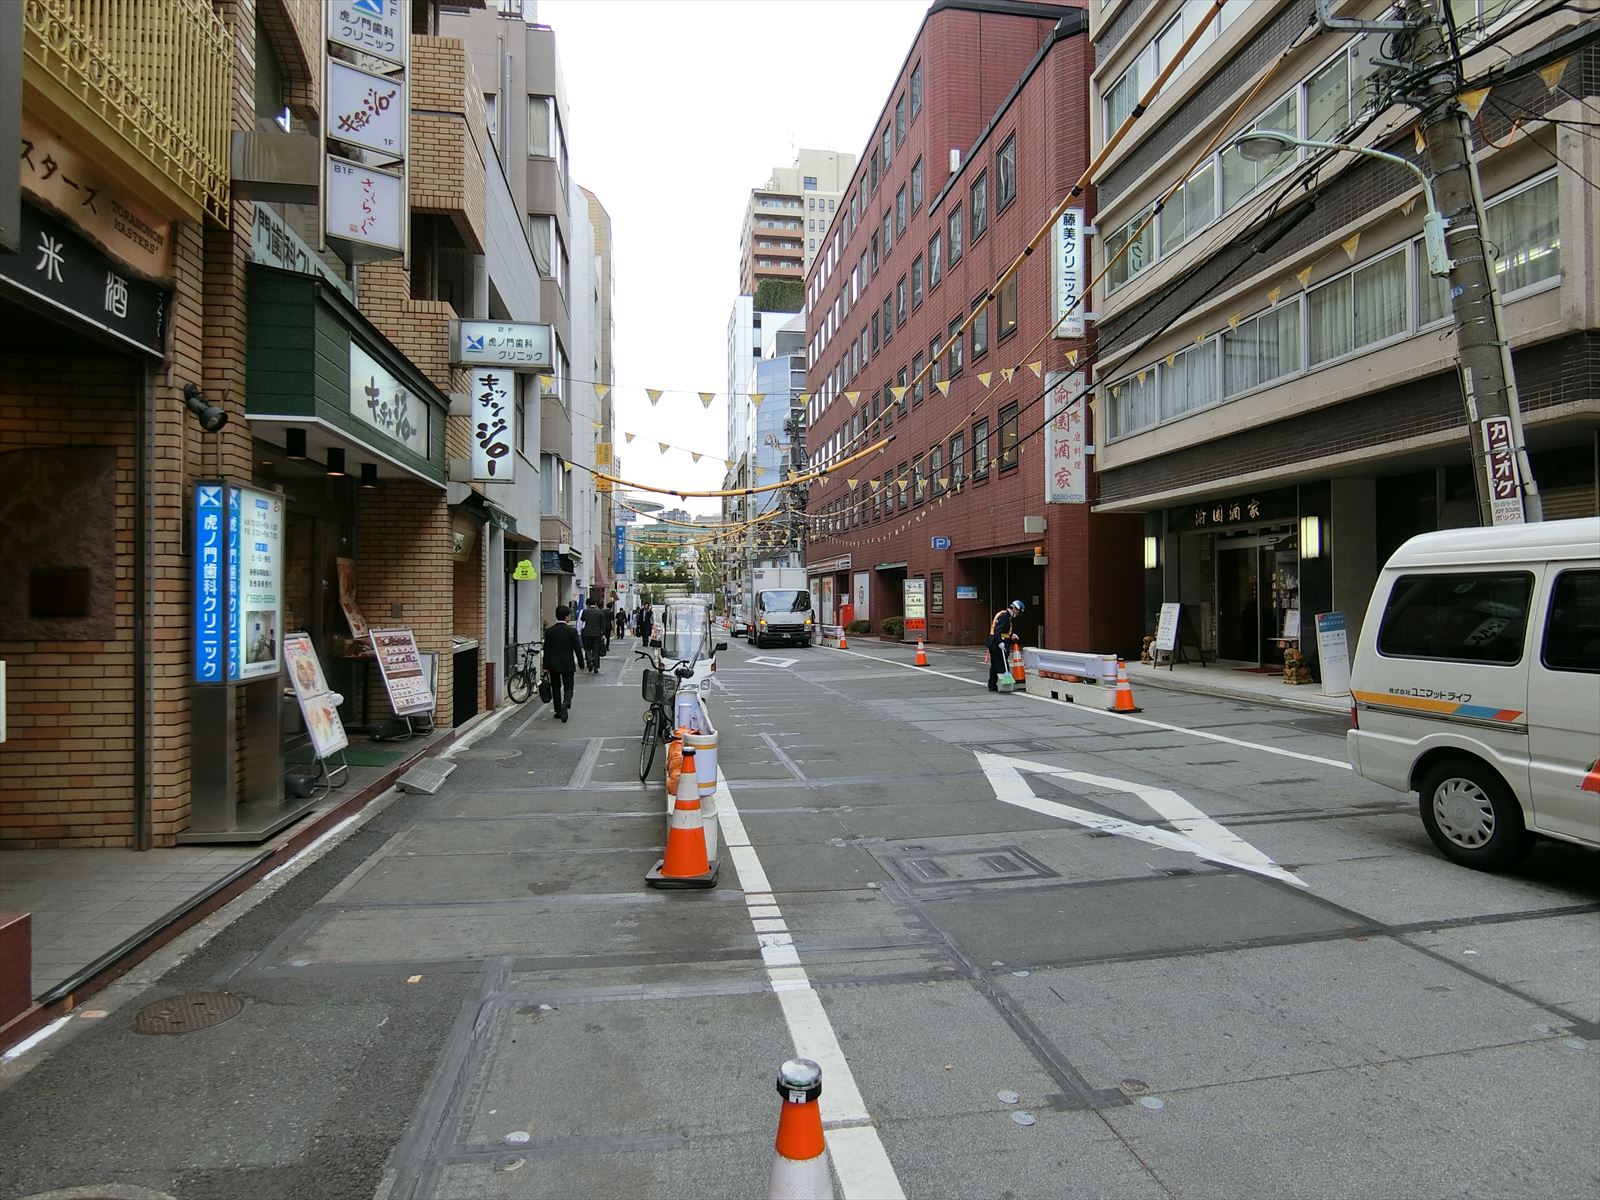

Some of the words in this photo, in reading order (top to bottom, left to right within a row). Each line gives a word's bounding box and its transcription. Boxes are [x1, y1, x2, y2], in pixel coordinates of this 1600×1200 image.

[340, 10, 393, 39] 虎ノ門歯科
[342, 26, 394, 52] クリニック
[384, 138, 394, 146] 1F
[334, 164, 353, 176] B1F
[361, 178, 376, 235] さくらさく
[36, 231, 65, 283] 米
[105, 270, 128, 318] 酒
[1063, 213, 1077, 307] 藤美クリニック
[488, 338, 533, 349] 虎ノ門歯科
[499, 352, 543, 362] クリニック
[475, 374, 510, 477] キッチンジロー
[1489, 423, 1515, 498] カラオケ
[937, 538, 946, 549] P
[203, 514, 218, 678] 虎ノ門歯科クリニック
[229, 516, 238, 677] 虎ノ門歯科クリニック
